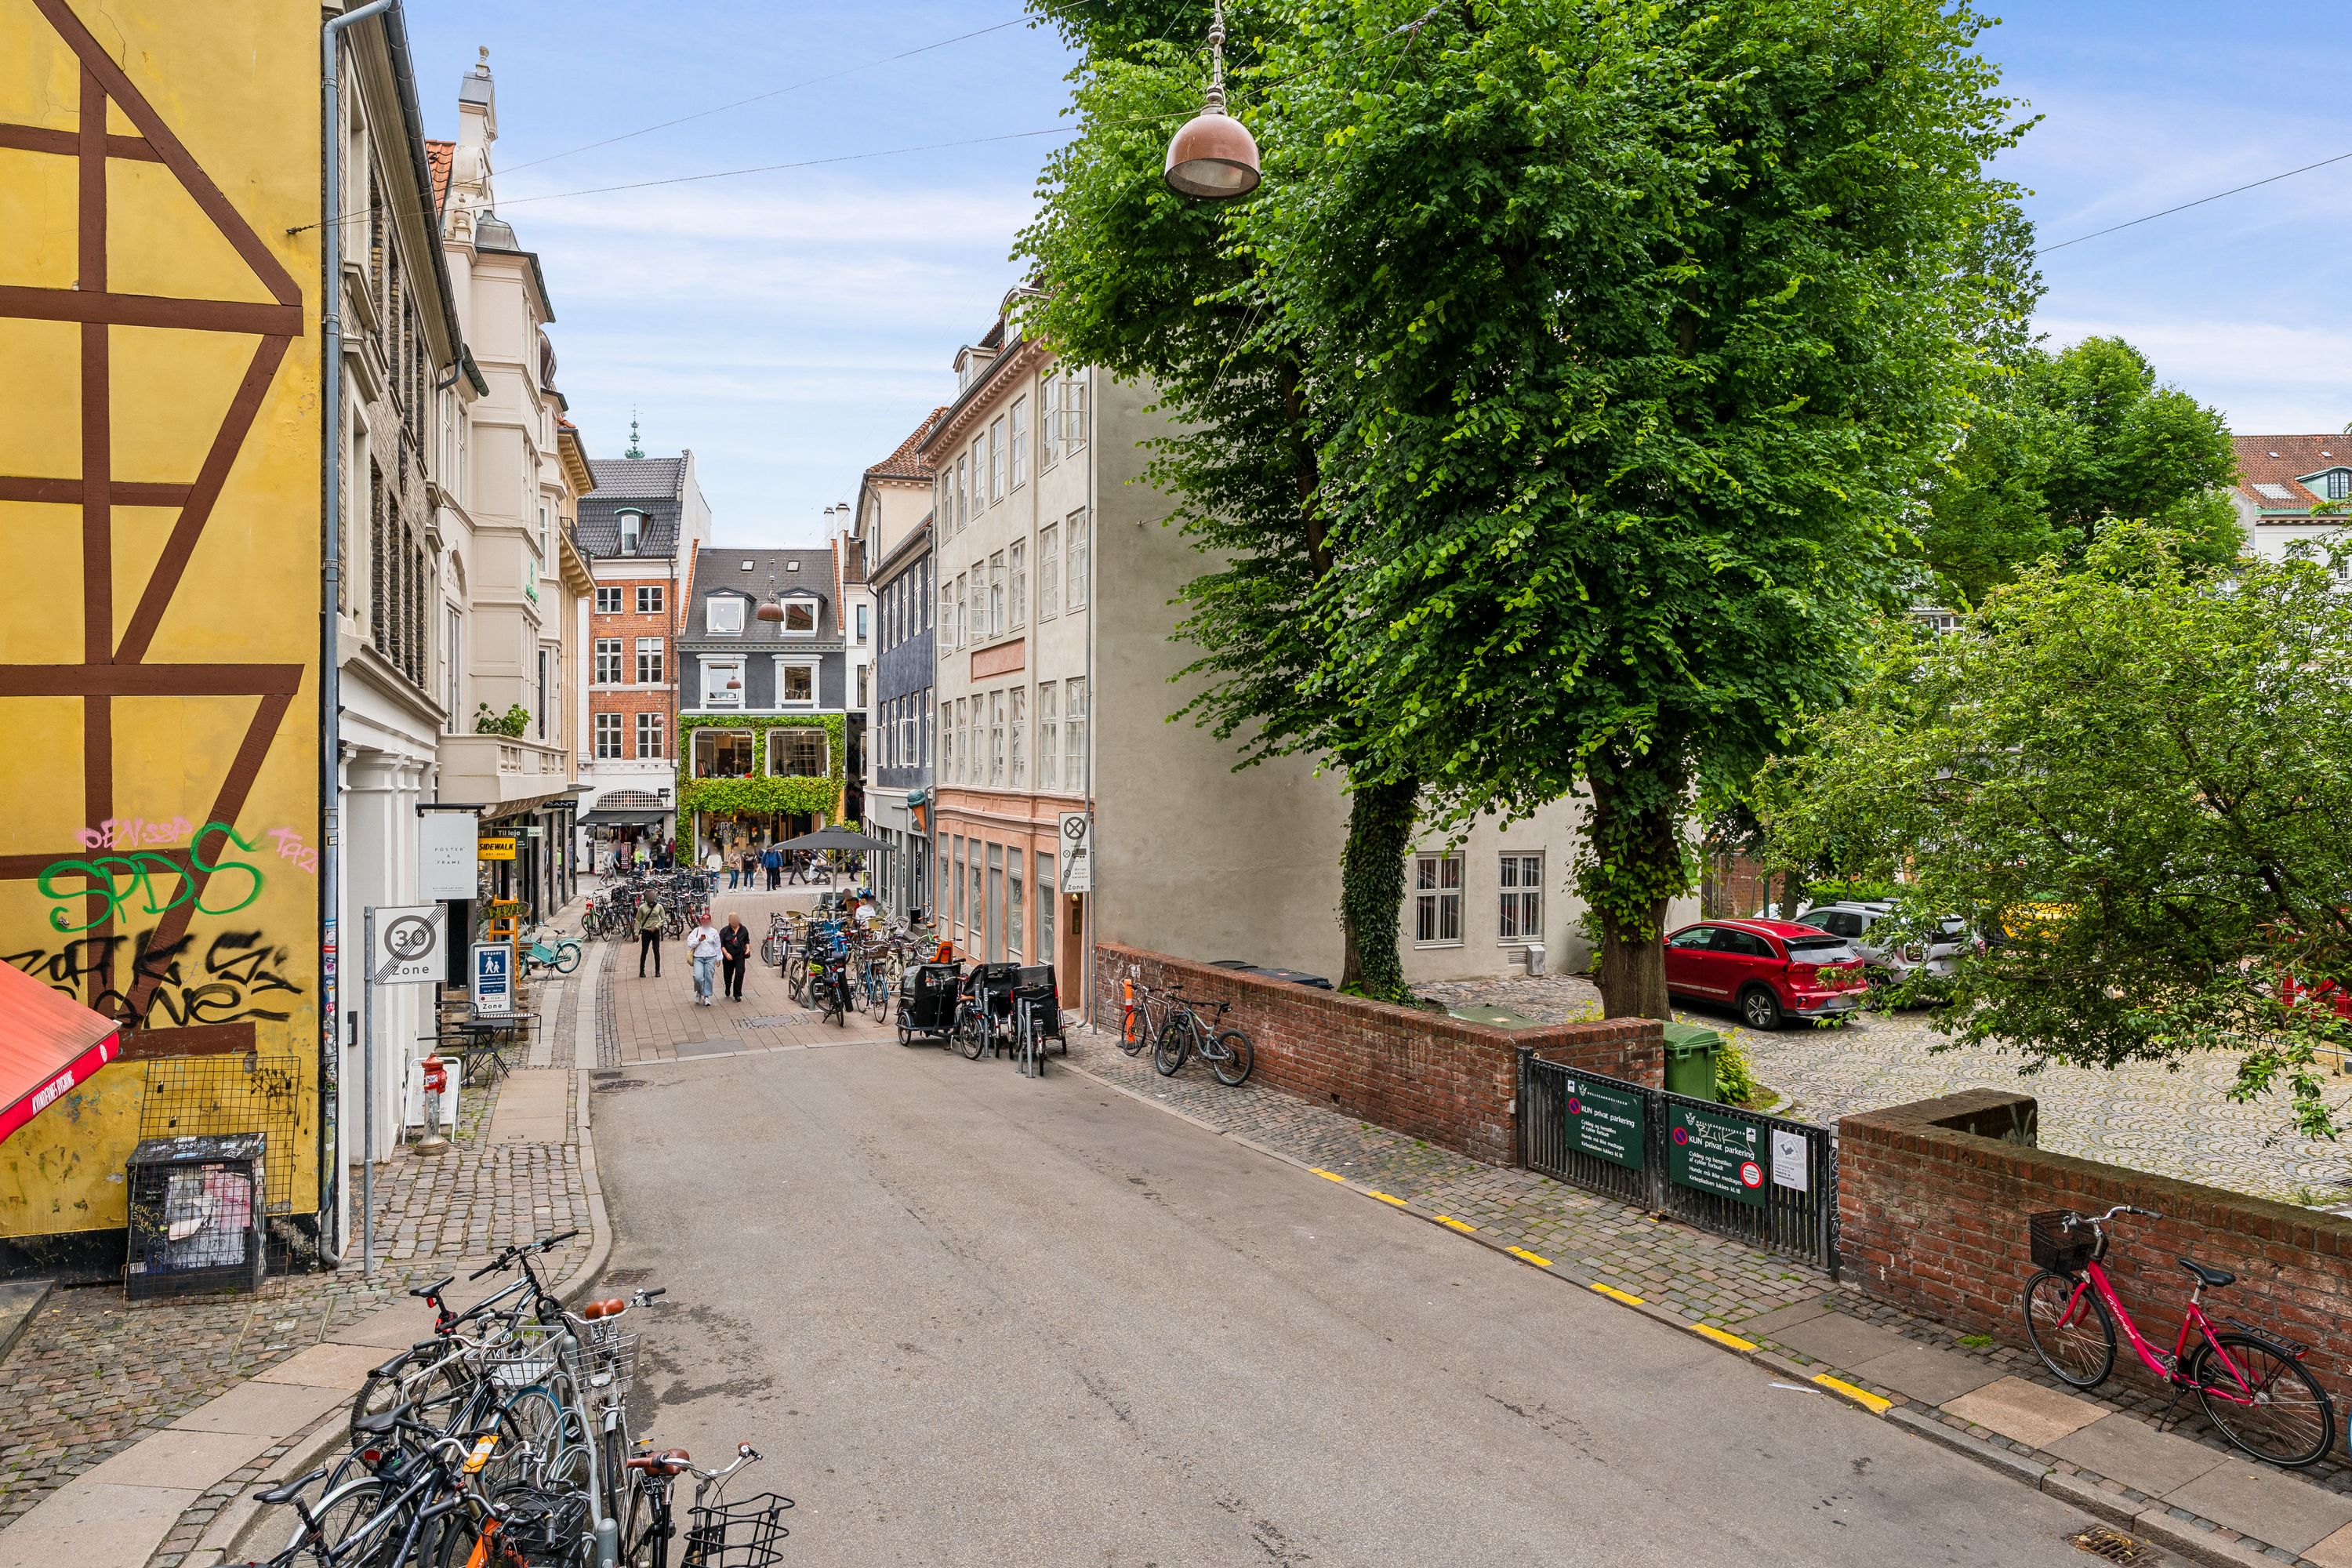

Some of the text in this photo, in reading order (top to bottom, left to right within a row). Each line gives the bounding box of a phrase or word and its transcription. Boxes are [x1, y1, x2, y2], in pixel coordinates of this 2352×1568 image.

[394, 930, 426, 946] 30
[392, 965, 430, 975] Zone
[1581, 1105, 1635, 1128] KUN privat parkering
[1581, 1141, 1602, 1152] Kirkepladsen
[1607, 1141, 1624, 1151] medtages
[1689, 1135, 1755, 1160] KUN privat parkering
[1689, 1151, 1704, 1160] Cykling
[1712, 1157, 1732, 1167] henstillen
[1708, 1162, 1723, 1171] forbudt
[1689, 1175, 1715, 1186] Kirkepladsen
[1715, 1182, 1730, 1191] lukkes
[1722, 1174, 1742, 1185] medtages
